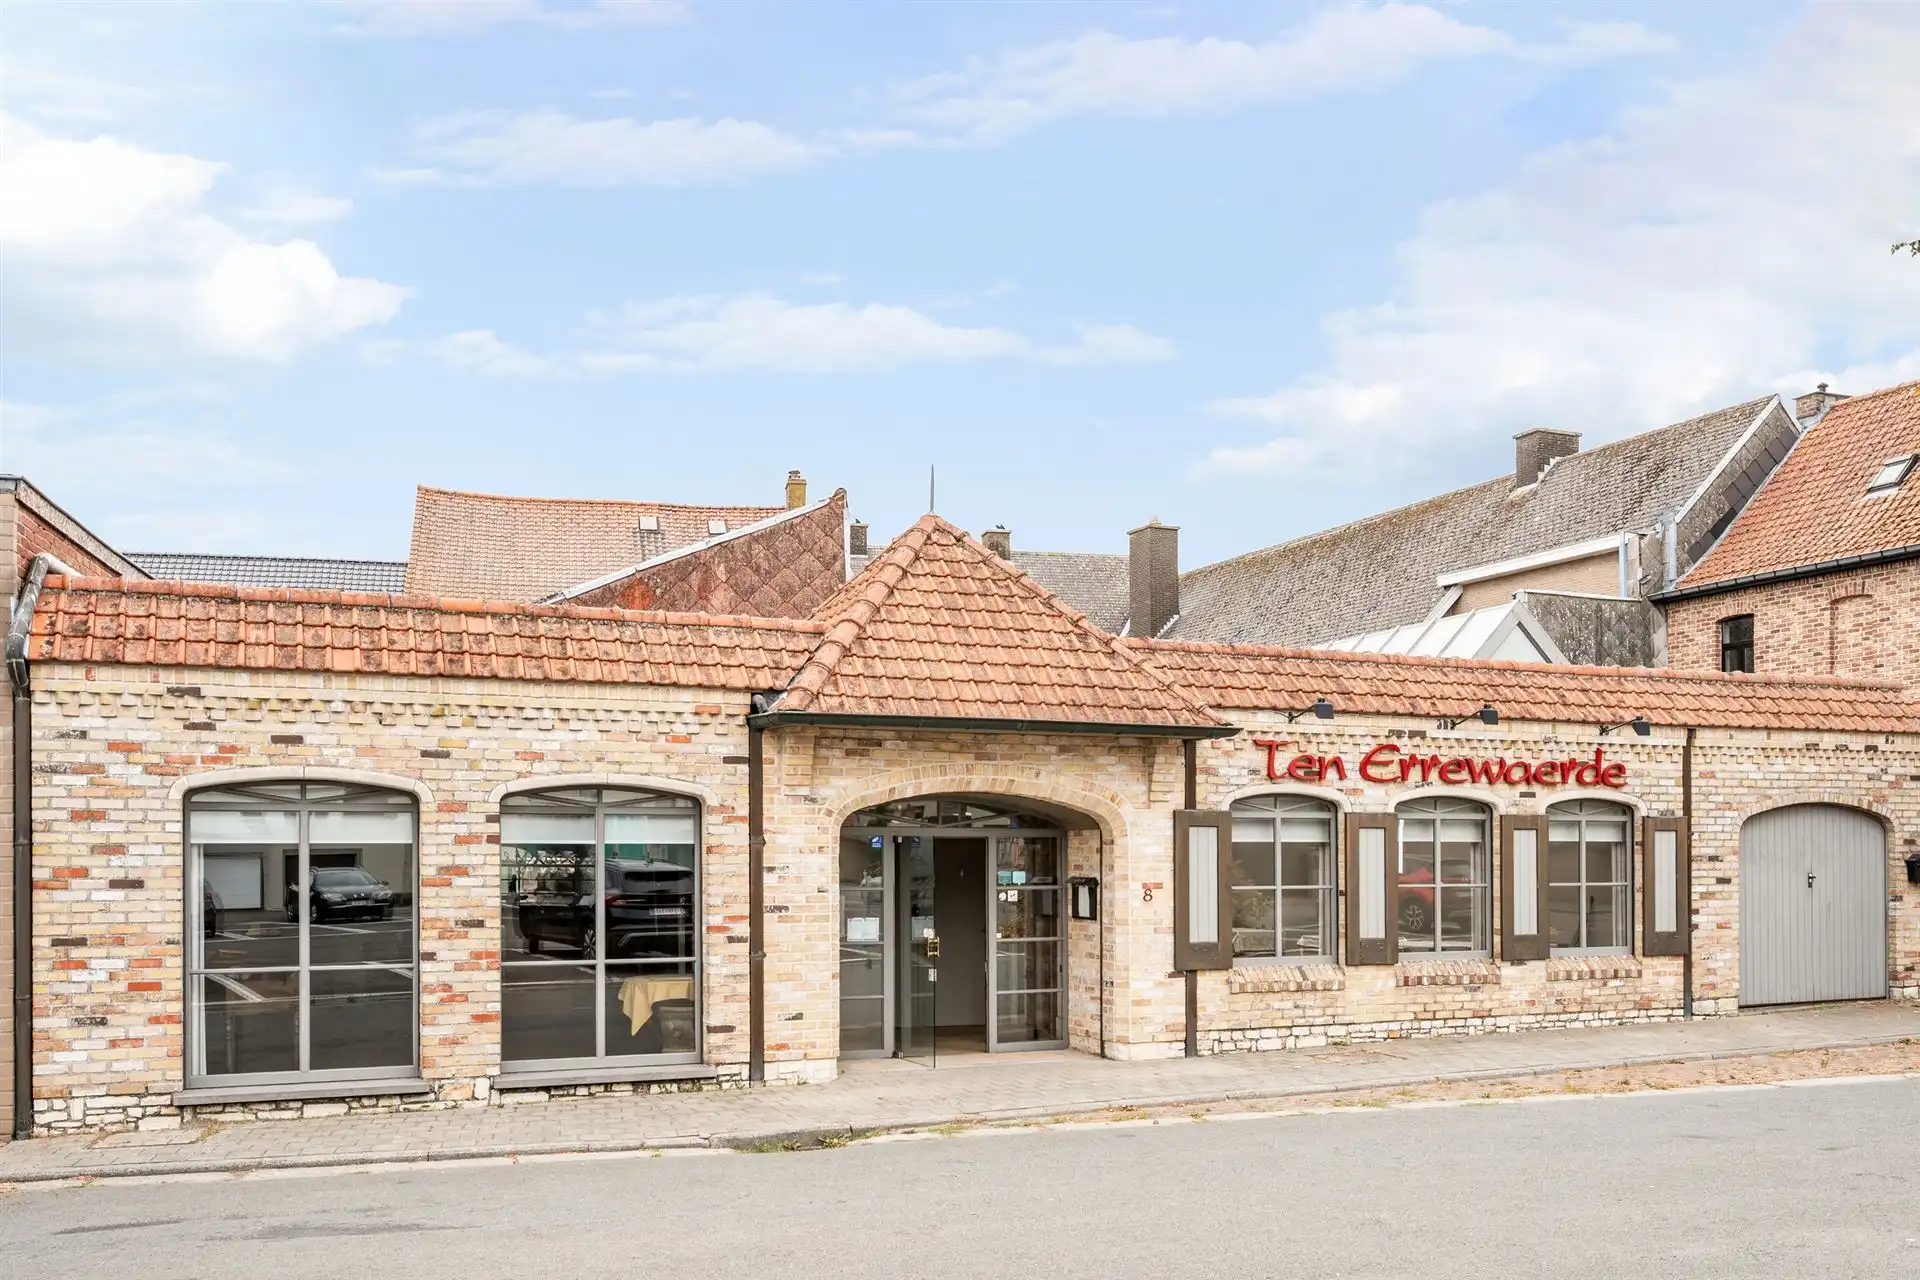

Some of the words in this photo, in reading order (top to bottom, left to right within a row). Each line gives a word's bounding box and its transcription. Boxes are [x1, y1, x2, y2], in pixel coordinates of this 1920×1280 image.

[1253, 739, 1348, 782] Ten
[1359, 744, 1627, 788] Errewaerde
[1143, 888, 1153, 902] 8
